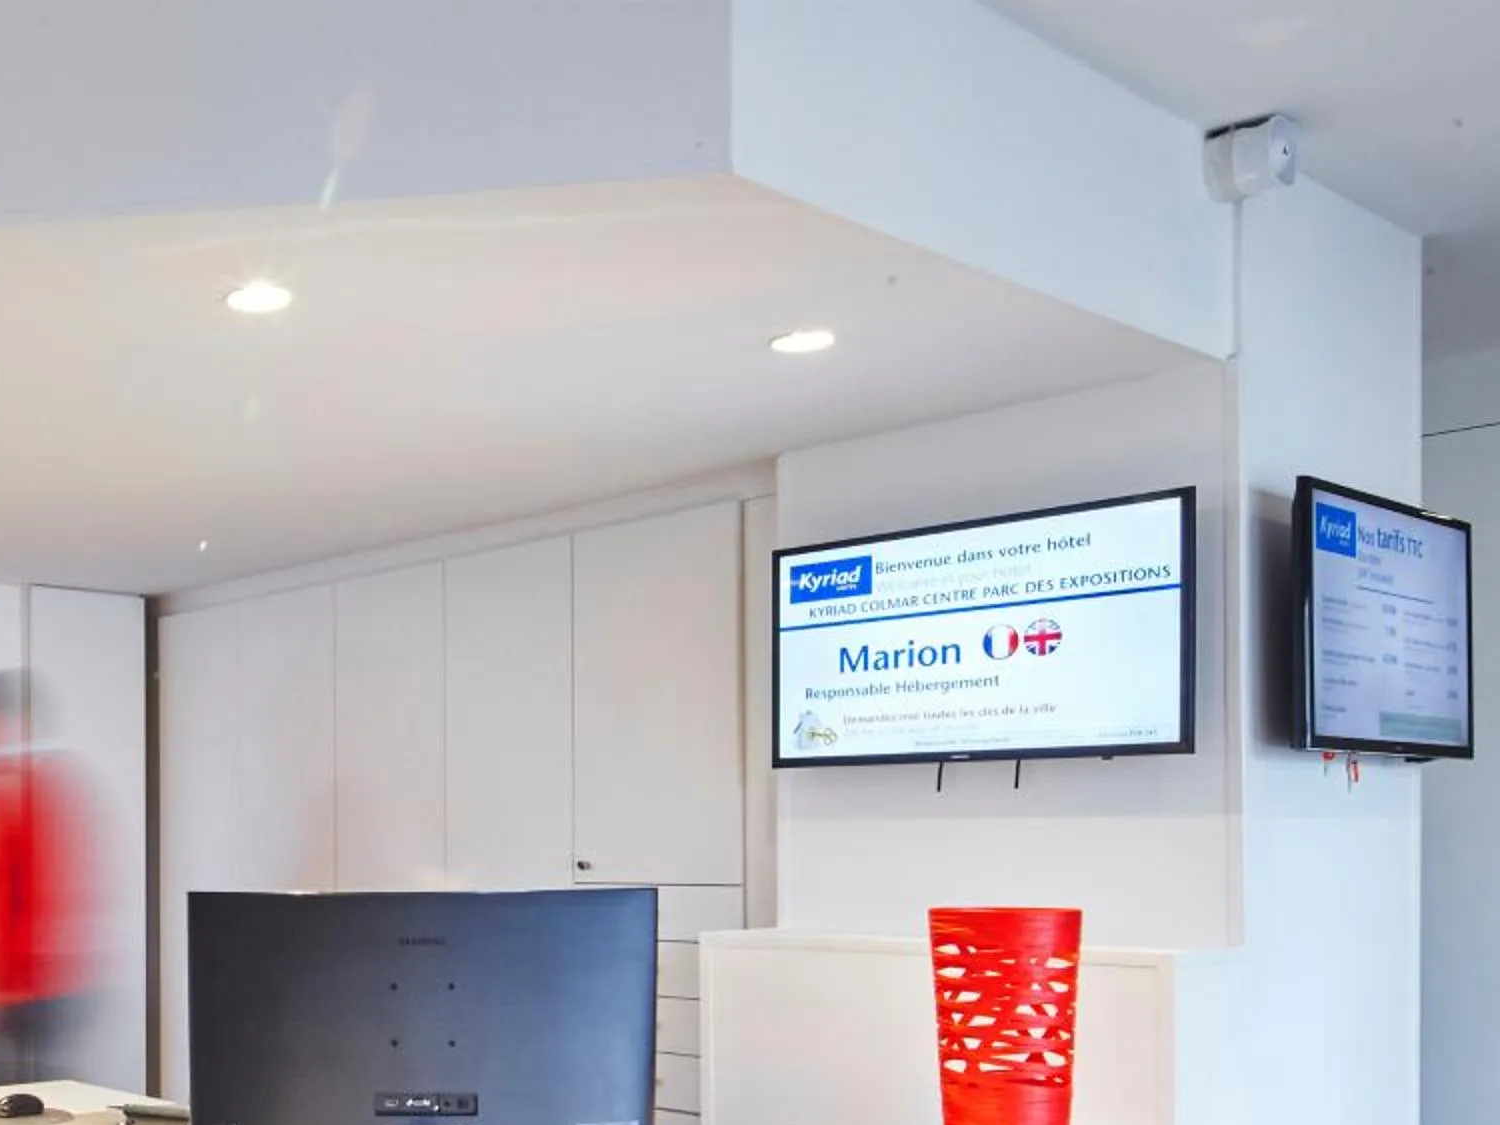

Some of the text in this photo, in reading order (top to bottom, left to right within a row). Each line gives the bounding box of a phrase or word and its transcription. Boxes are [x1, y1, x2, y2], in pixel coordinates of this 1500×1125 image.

[1320, 515, 1351, 539] Kyriad
[1377, 528, 1405, 553] tarifs
[875, 532, 1091, 574] Bienvenue dans votre hôtel
[800, 565, 862, 592] Kyriad
[809, 565, 1171, 618] KYRIAD COLMAR CENTRE PARC DES EXPOSITIONS
[839, 640, 961, 674] Marion
[805, 674, 1000, 701] Responsable Hébergement
